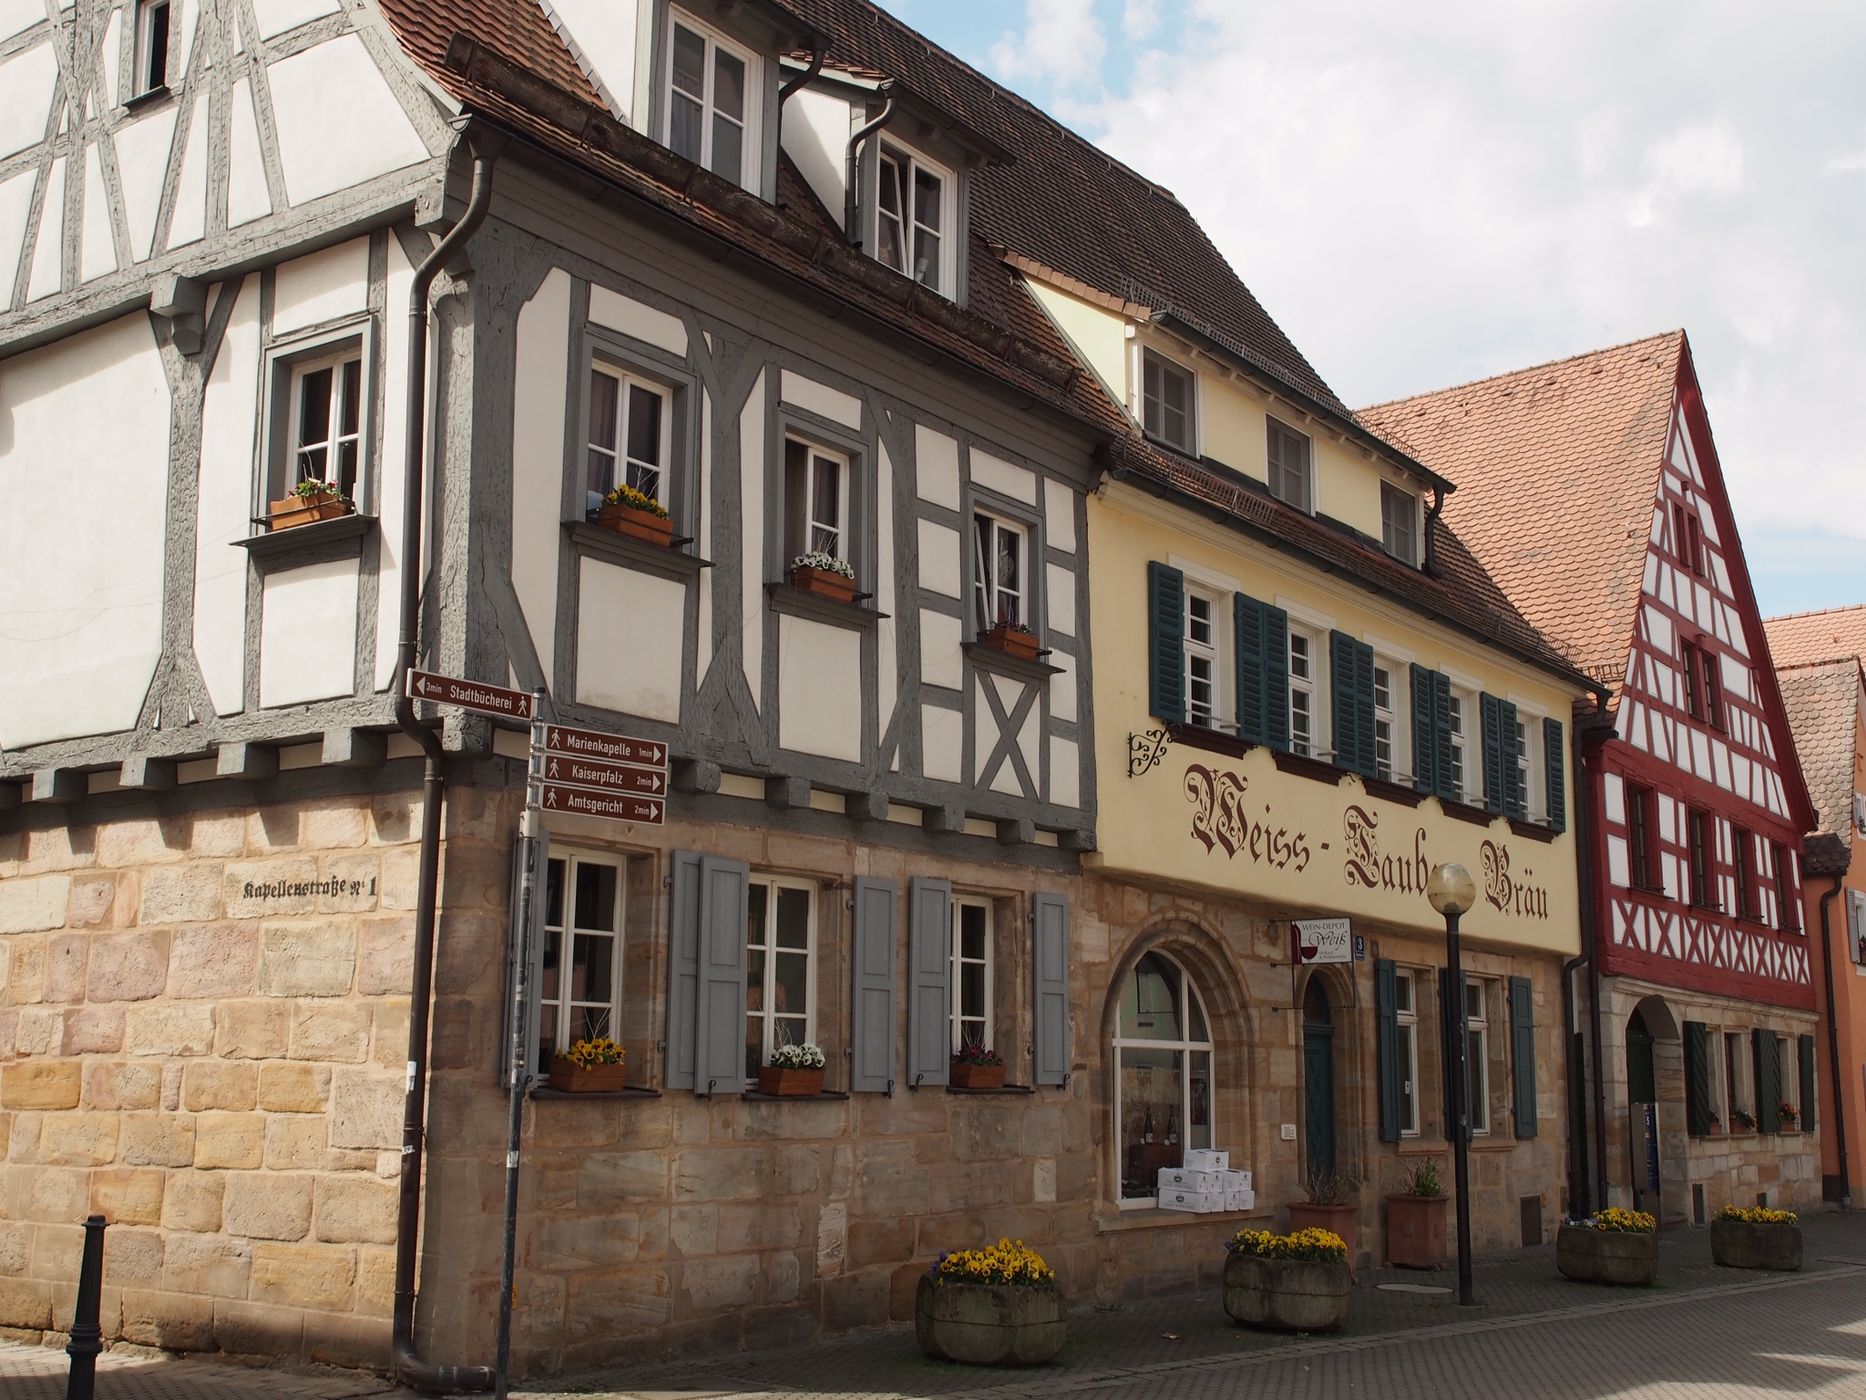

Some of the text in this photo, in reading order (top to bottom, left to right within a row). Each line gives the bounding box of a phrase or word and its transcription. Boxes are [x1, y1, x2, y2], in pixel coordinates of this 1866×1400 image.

[426, 681, 512, 710] 3min Stadtbücherei
[567, 735, 652, 758] Marienkapelle 1min
[572, 764, 651, 786] Kaiserpfalz 2min
[567, 793, 650, 816] Amtsgericht 2min
[1344, 805, 1437, 896] Taub
[1480, 839, 1548, 920] Bräu
[243, 875, 346, 901] Kapellenstraße
[368, 876, 377, 896] 1
[1357, 936, 1363, 951] 3
